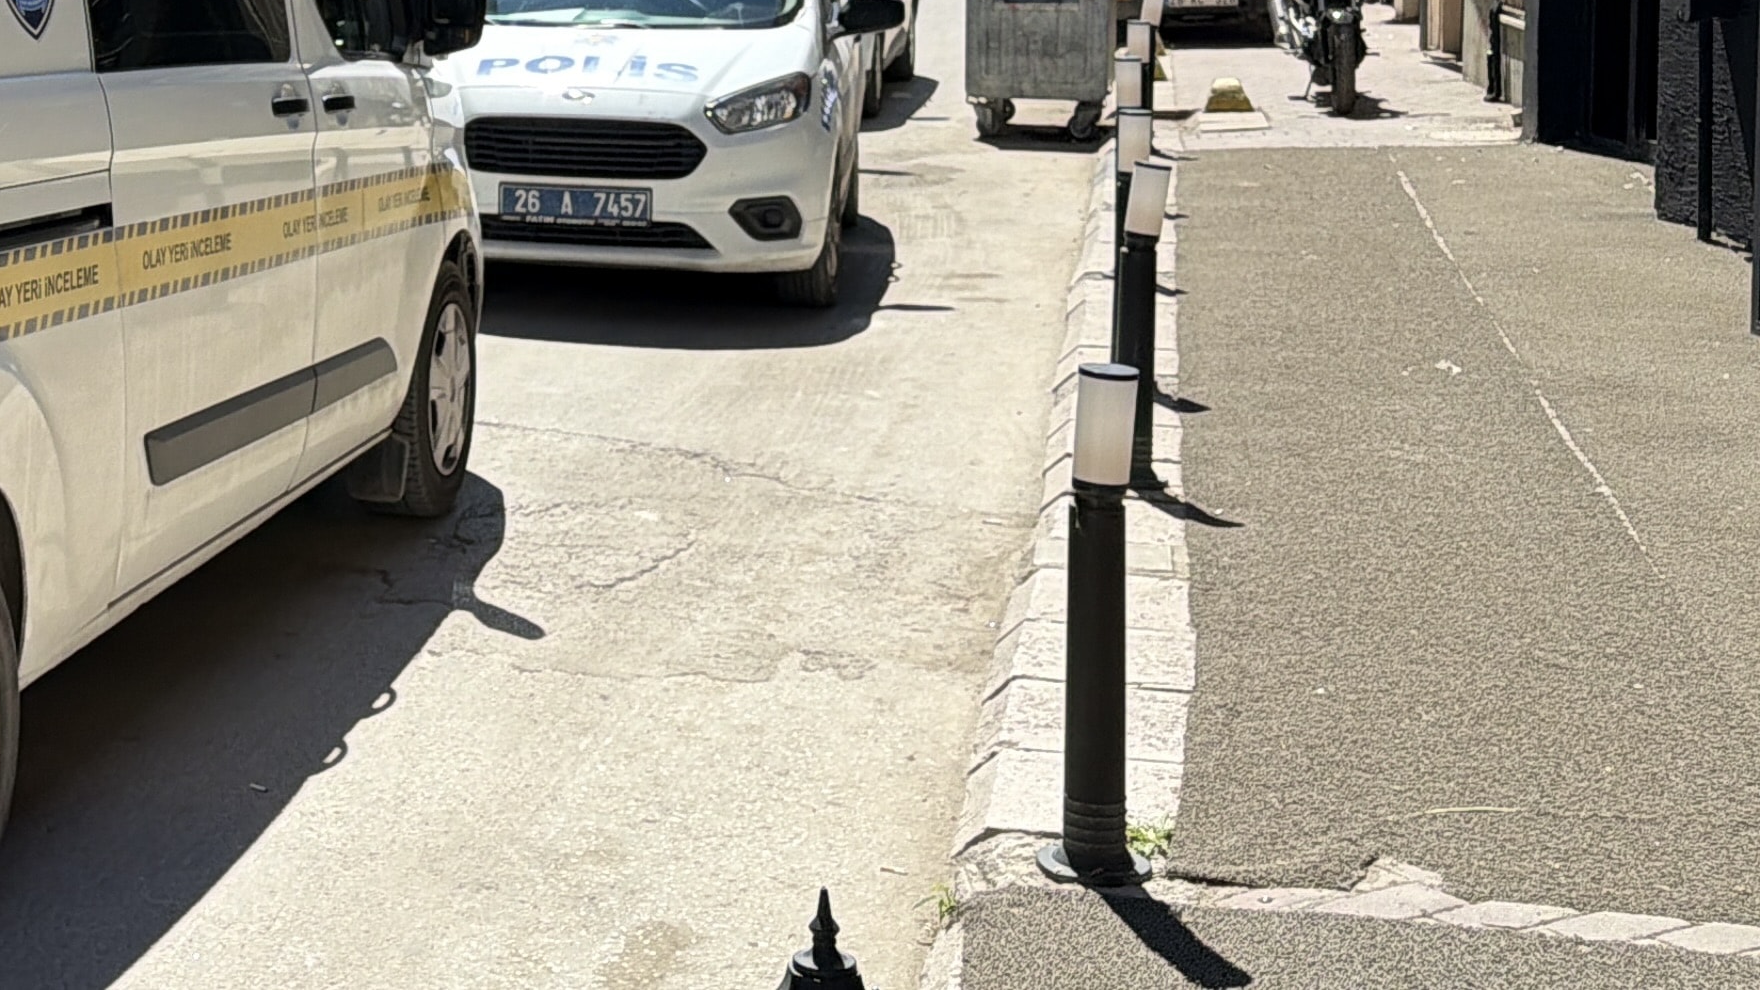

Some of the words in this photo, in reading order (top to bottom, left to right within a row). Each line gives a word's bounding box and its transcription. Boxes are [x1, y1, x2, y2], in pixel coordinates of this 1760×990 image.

[514, 190, 540, 213] 26
[560, 191, 573, 215] A
[593, 193, 647, 218] 7457
[142, 247, 167, 271] OLAY
